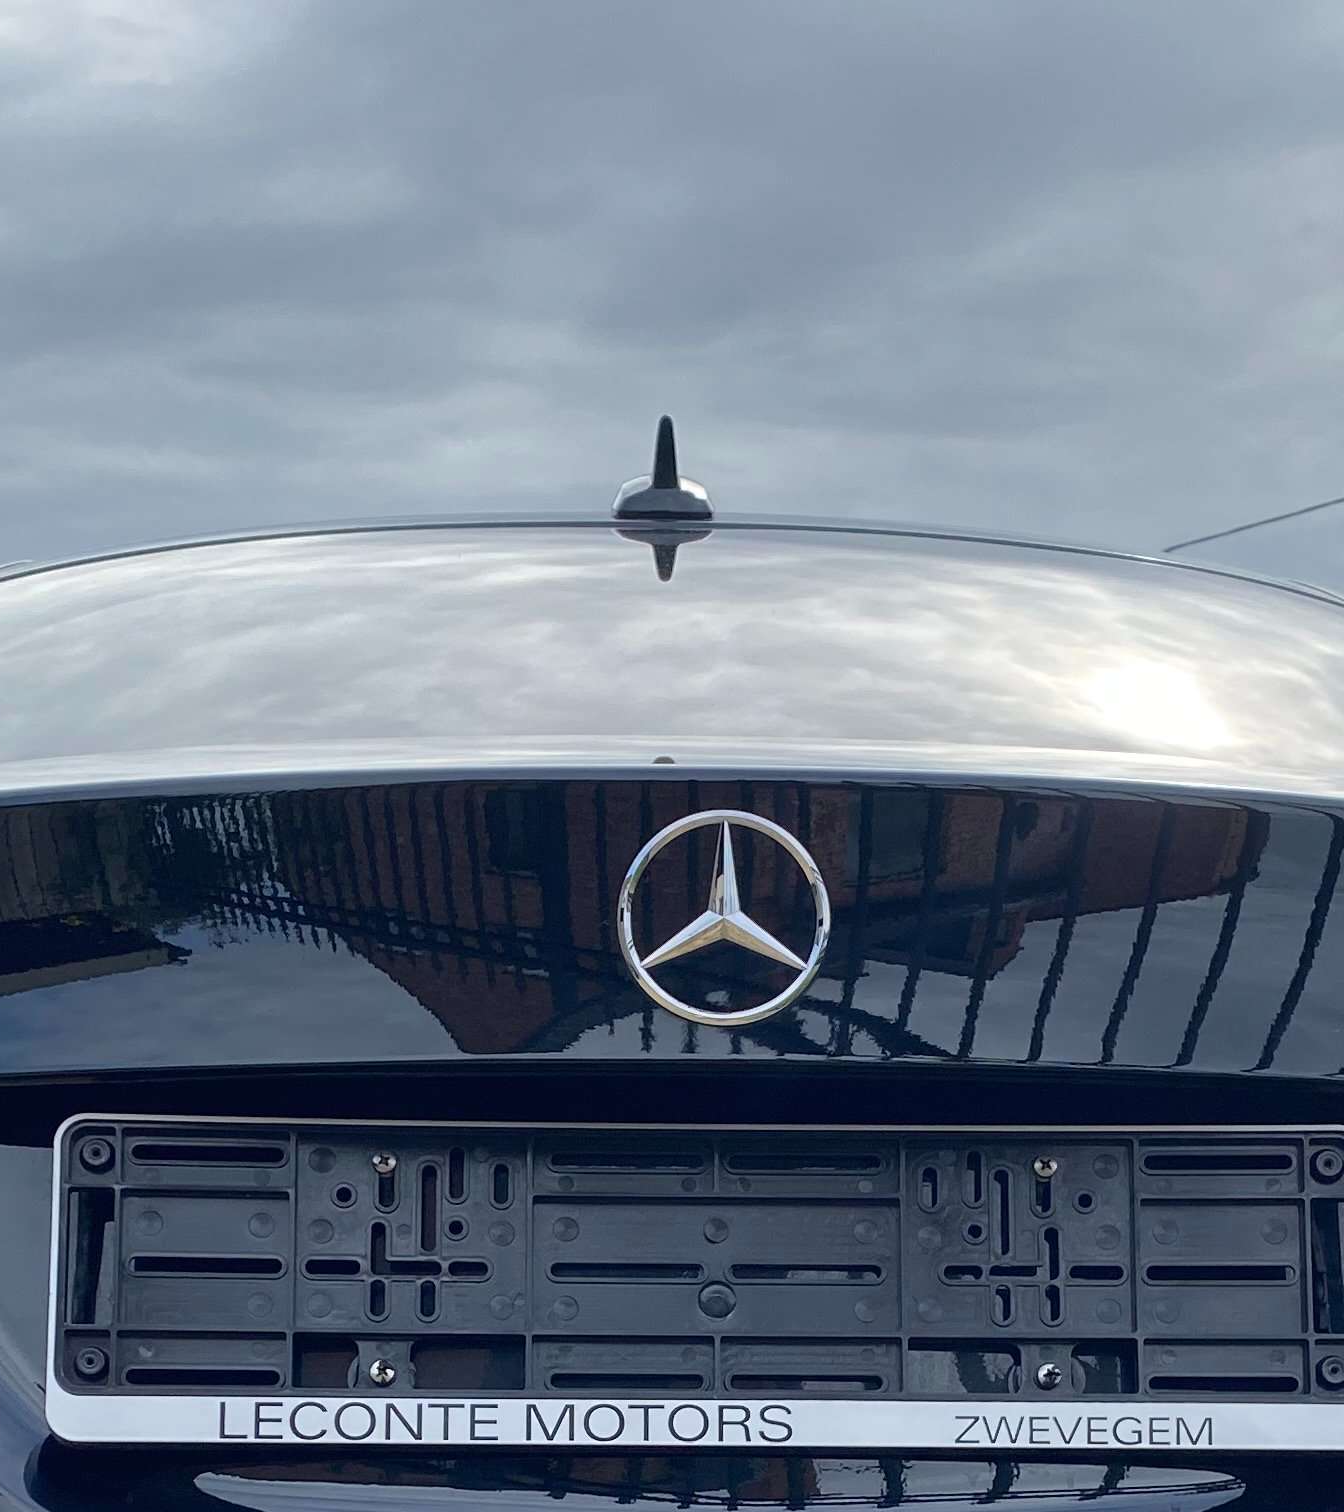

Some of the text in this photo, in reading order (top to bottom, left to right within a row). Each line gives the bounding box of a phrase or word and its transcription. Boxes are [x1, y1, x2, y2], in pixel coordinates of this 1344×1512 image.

[218, 1401, 1213, 1446] LECONTE MOTORS ZWEVEGEM
